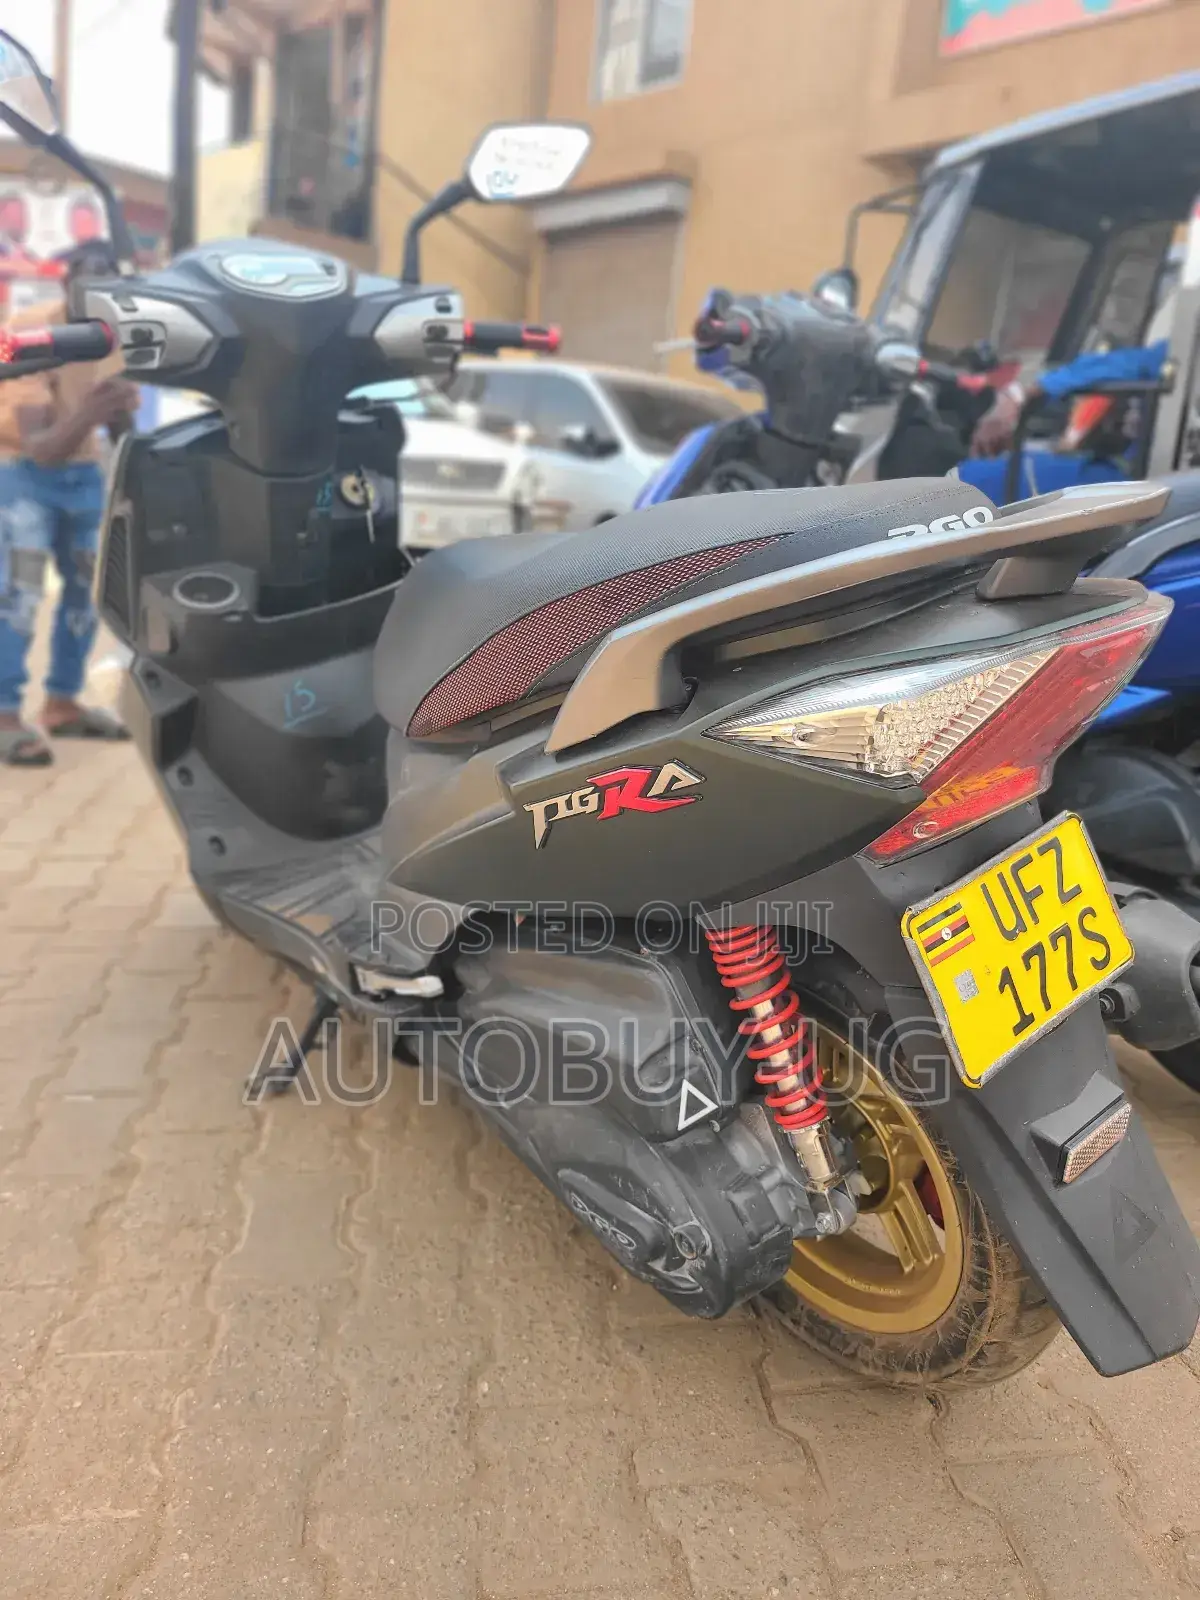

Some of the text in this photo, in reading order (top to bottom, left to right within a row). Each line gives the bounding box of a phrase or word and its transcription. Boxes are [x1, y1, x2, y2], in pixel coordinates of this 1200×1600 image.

[522, 758, 707, 850] TIGRA
[980, 836, 1082, 941] UFZ
[998, 906, 1111, 1036] 177S
